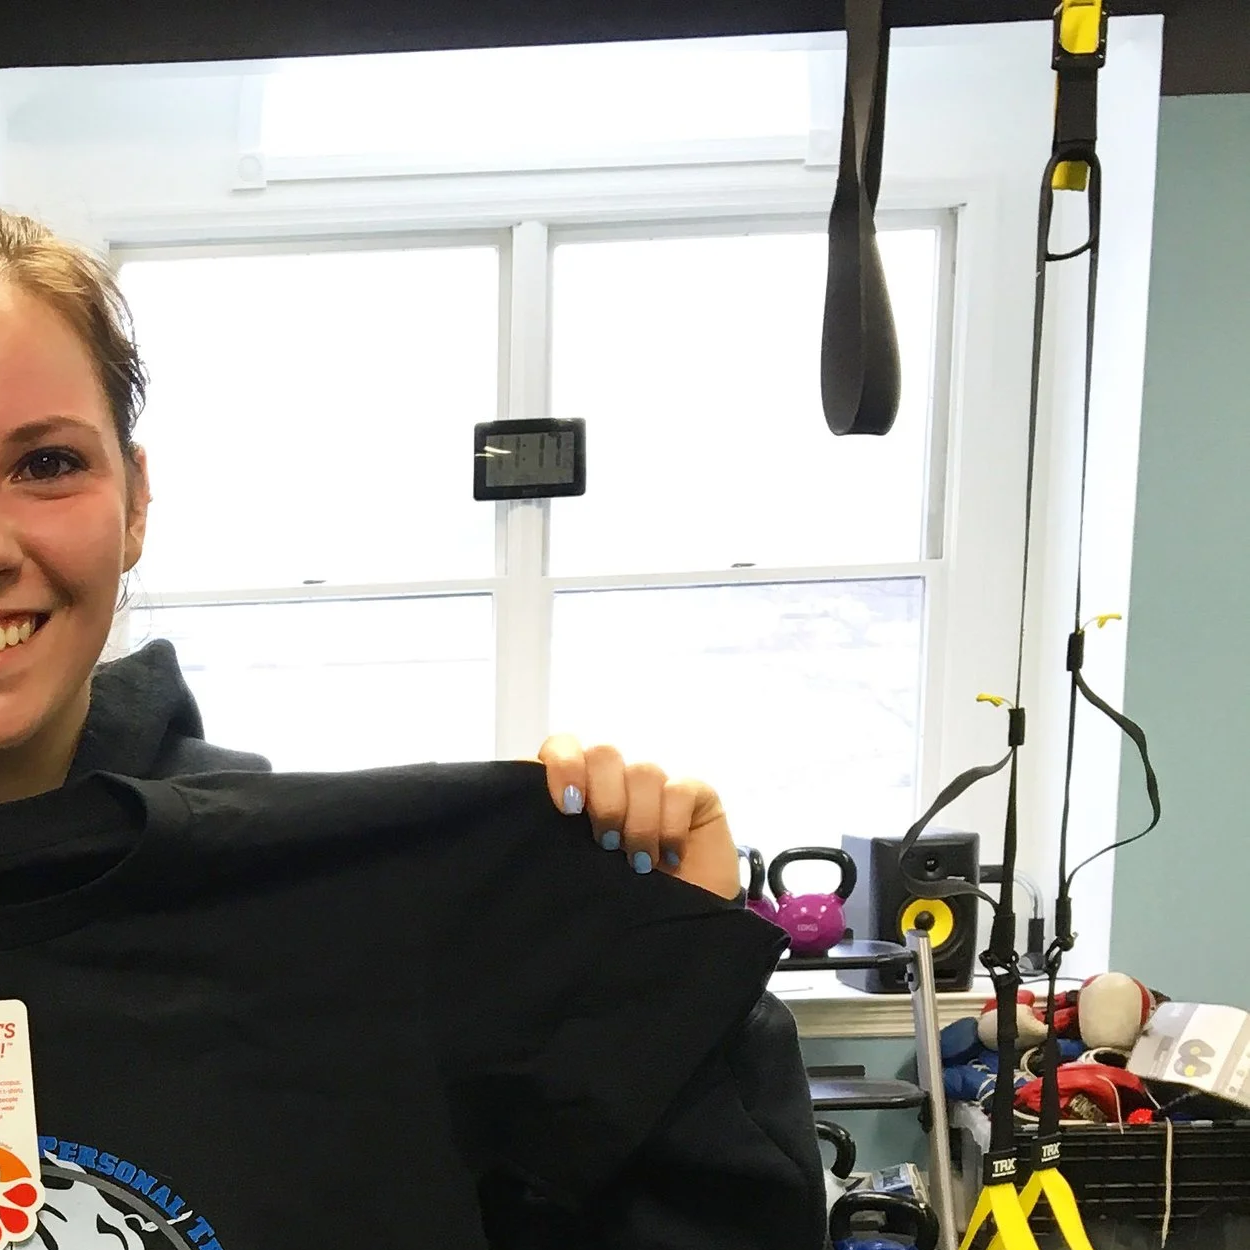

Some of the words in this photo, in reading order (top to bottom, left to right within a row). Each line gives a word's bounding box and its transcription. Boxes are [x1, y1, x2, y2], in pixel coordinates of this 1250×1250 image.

[1042, 1142, 1062, 1158] TRX
[992, 1157, 1018, 1173] TRX
[38, 1135, 186, 1220] PERSONAL
